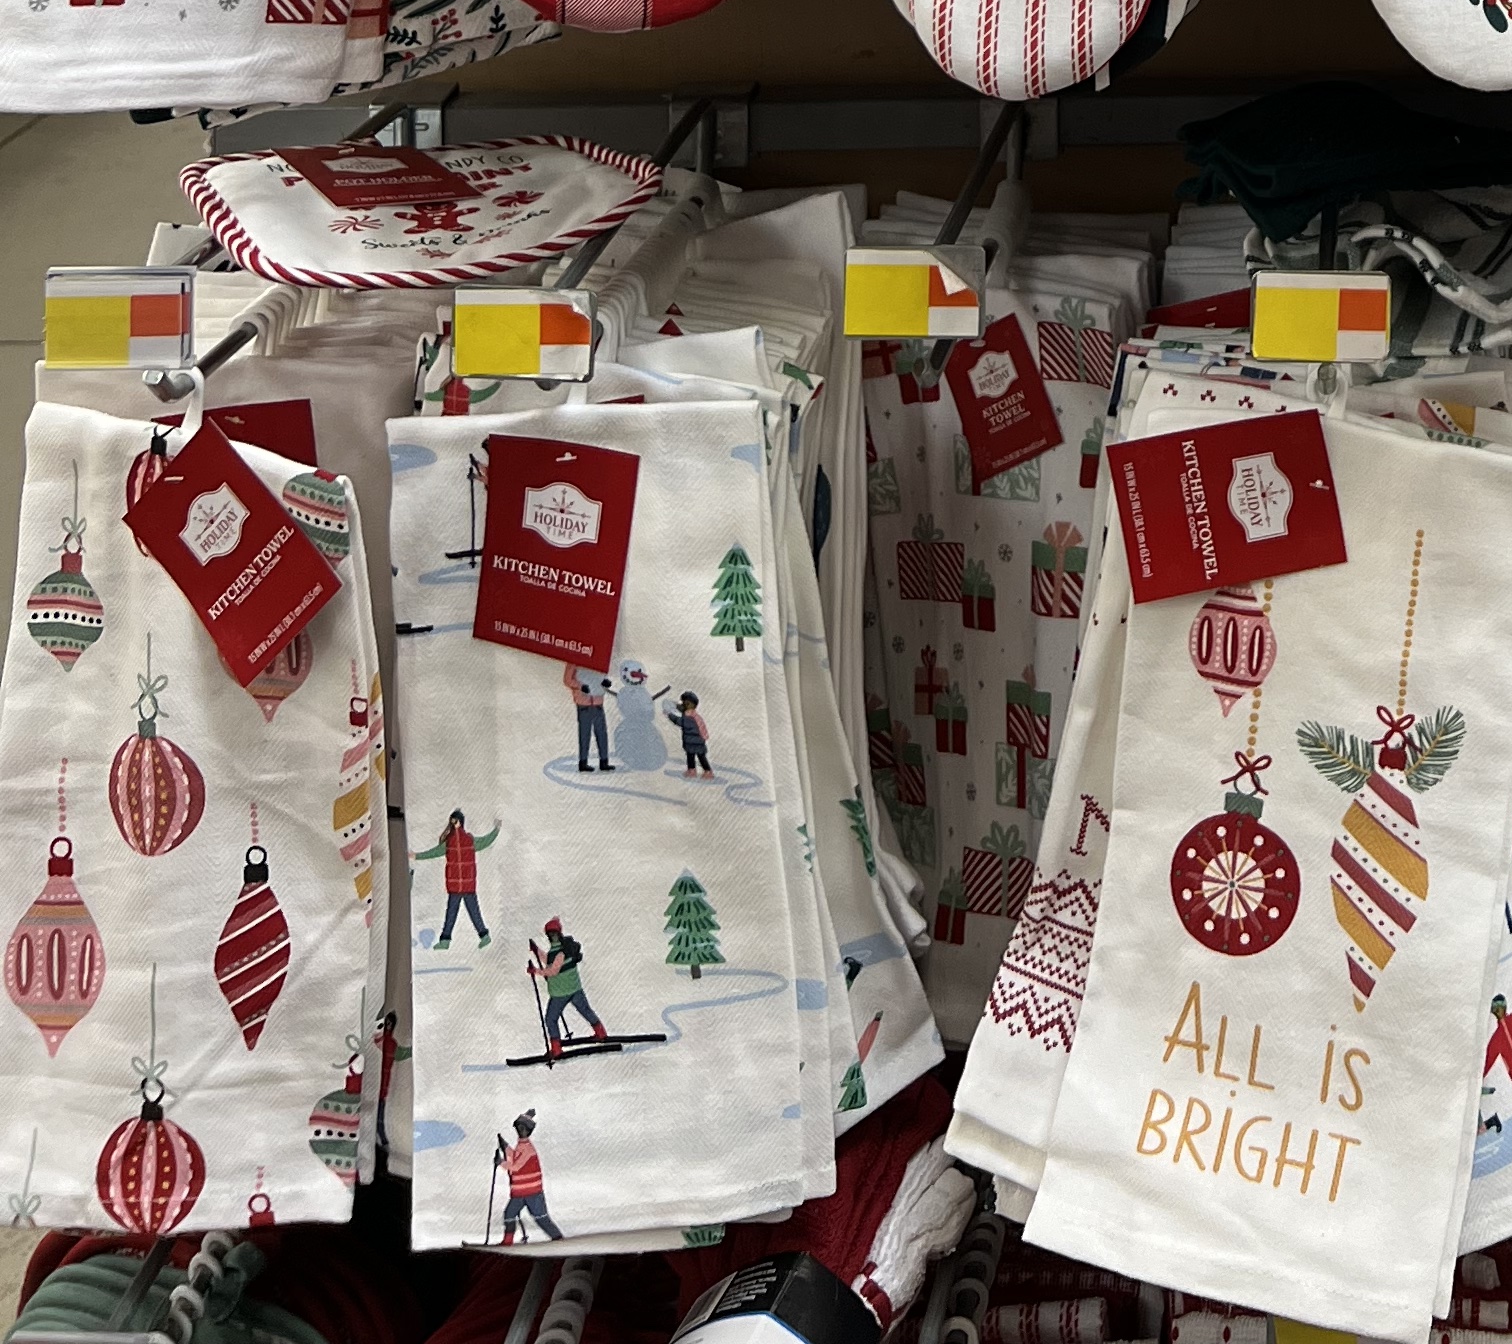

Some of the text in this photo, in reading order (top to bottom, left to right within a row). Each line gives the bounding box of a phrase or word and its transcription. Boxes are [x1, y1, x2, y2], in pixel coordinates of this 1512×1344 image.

[982, 390, 1026, 418] KITCHEN
[989, 404, 1026, 427] TOWEL
[1181, 440, 1218, 580] KITCHEN TOWEL
[1237, 484, 1250, 515] TIME
[1241, 467, 1263, 527] HOLIDAY
[200, 510, 240, 553] HOLIDAY
[534, 511, 588, 534] HOLIDAY
[546, 528, 573, 540] TIME
[208, 565, 256, 620] KITCHEN
[252, 523, 294, 571] TOWEL
[493, 555, 616, 596] KITCHEN TOWEL
[520, 575, 586, 597] TOALLA DE COCINA
[1162, 980, 1275, 1090] ALL
